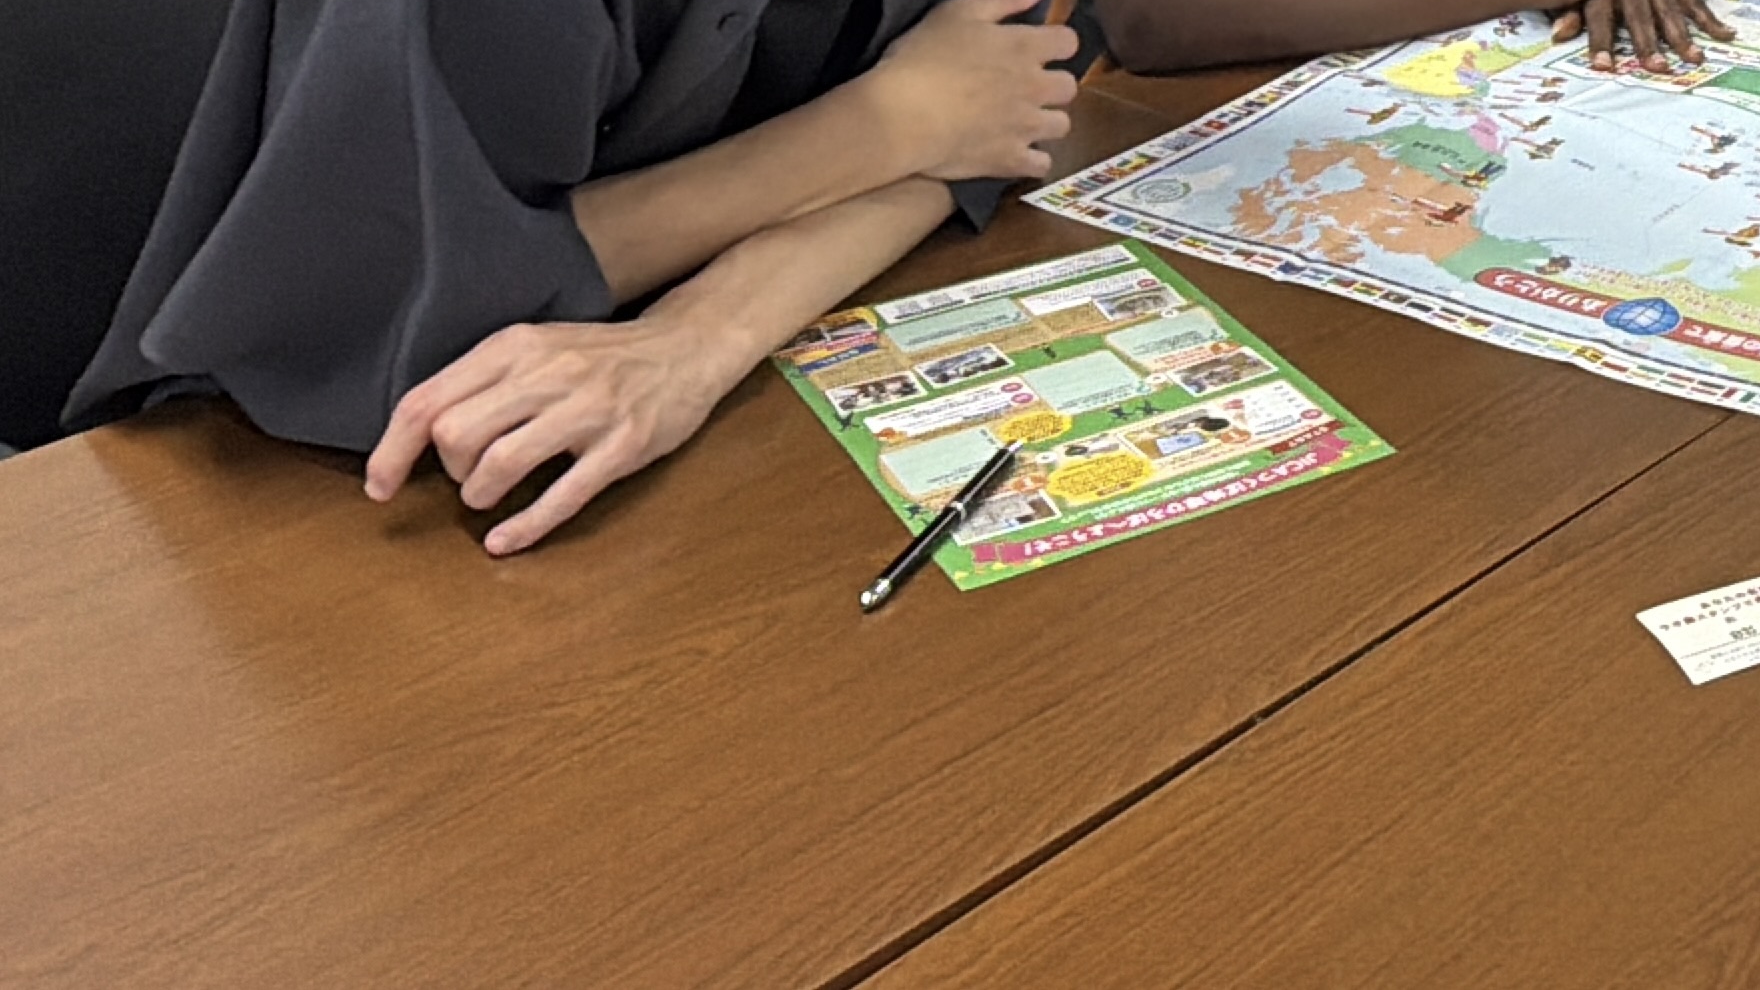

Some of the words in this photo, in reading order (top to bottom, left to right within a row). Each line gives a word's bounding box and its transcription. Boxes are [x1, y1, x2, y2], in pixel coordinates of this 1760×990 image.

[1494, 273, 1608, 311] ありがとう
